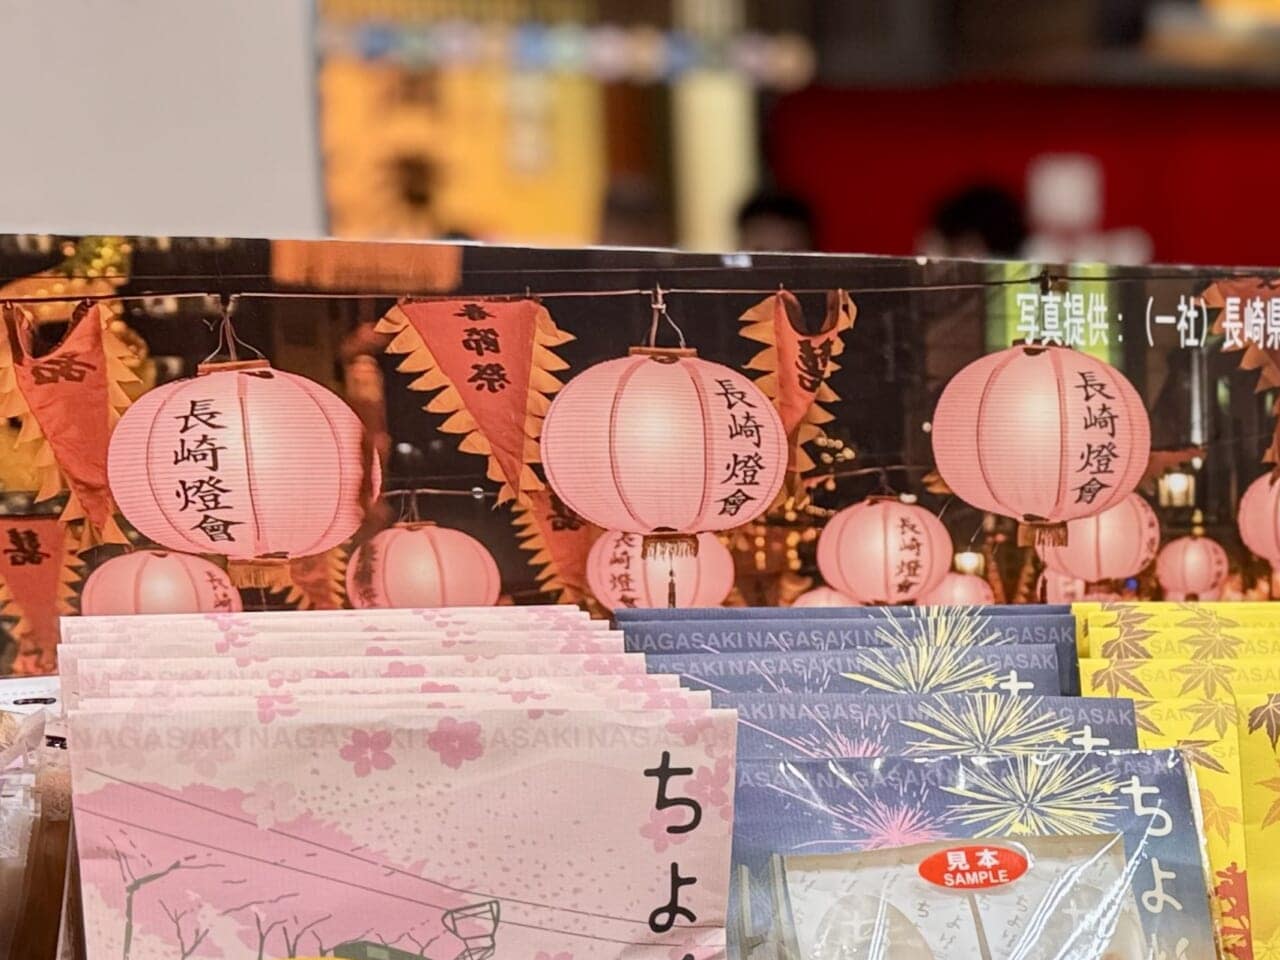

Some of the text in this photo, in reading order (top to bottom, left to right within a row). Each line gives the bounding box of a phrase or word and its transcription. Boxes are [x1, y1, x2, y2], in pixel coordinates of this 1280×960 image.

[173, 399, 246, 543] 長崎燈會
[715, 378, 766, 517] 長崎燈會
[1071, 371, 1121, 504] 長崎燈會
[625, 632, 743, 650] NAGASAKI
[944, 869, 1010, 887] SAMPLE
[947, 850, 1000, 871] 見本
